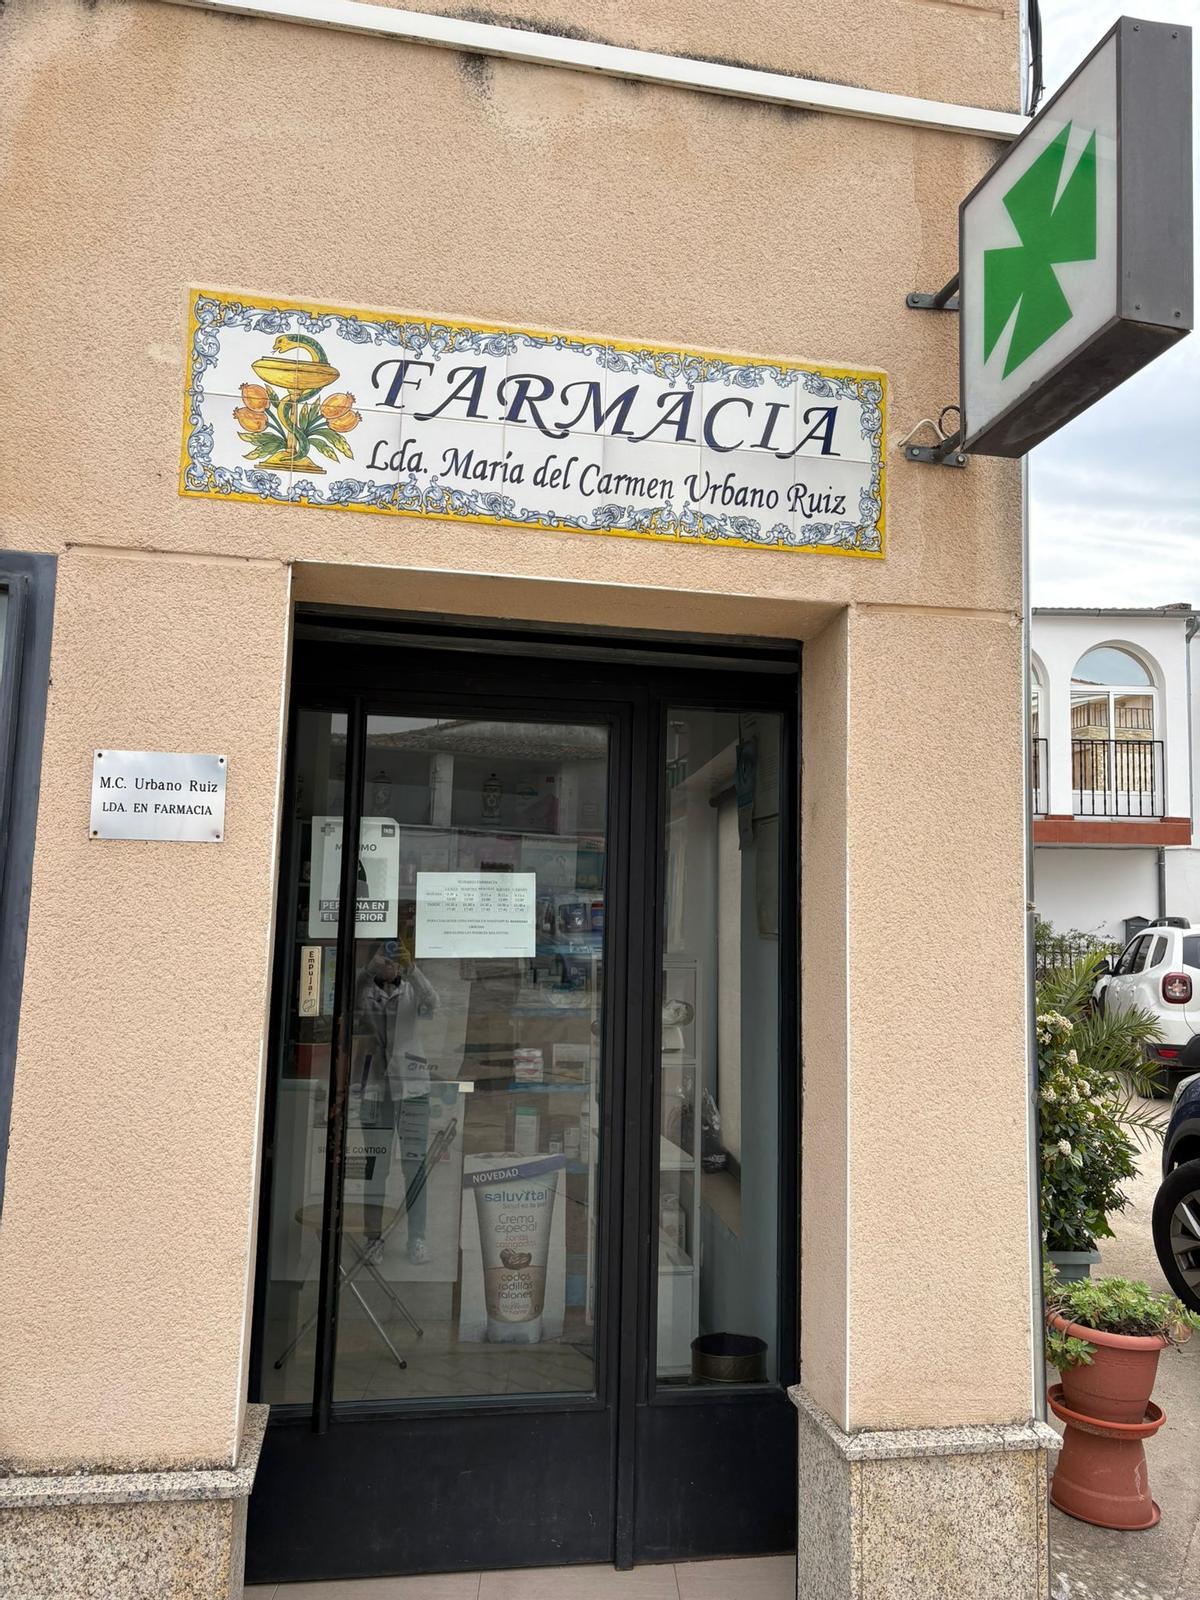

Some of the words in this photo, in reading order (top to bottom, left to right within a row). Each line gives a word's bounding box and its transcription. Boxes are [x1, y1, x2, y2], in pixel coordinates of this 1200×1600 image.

[371, 359, 841, 460] FARMACIA
[366, 438, 428, 474] Lda.
[439, 447, 524, 483] María
[533, 454, 579, 489] del
[579, 463, 675, 499] Carmen
[684, 470, 779, 510] Urbano
[787, 483, 847, 518] Ruiz
[100, 776, 127, 789] M.C.
[135, 778, 182, 792] Urbano
[189, 780, 218, 793] Ruiz
[102, 802, 127, 813] LDA.
[133, 803, 148, 813] EN
[154, 803, 213, 816] FARMACIA
[372, 902, 385, 910] EN
[323, 913, 334, 921] EL
[307, 951, 315, 996] Empujar
[472, 1168, 519, 1183] NOVEDAD
